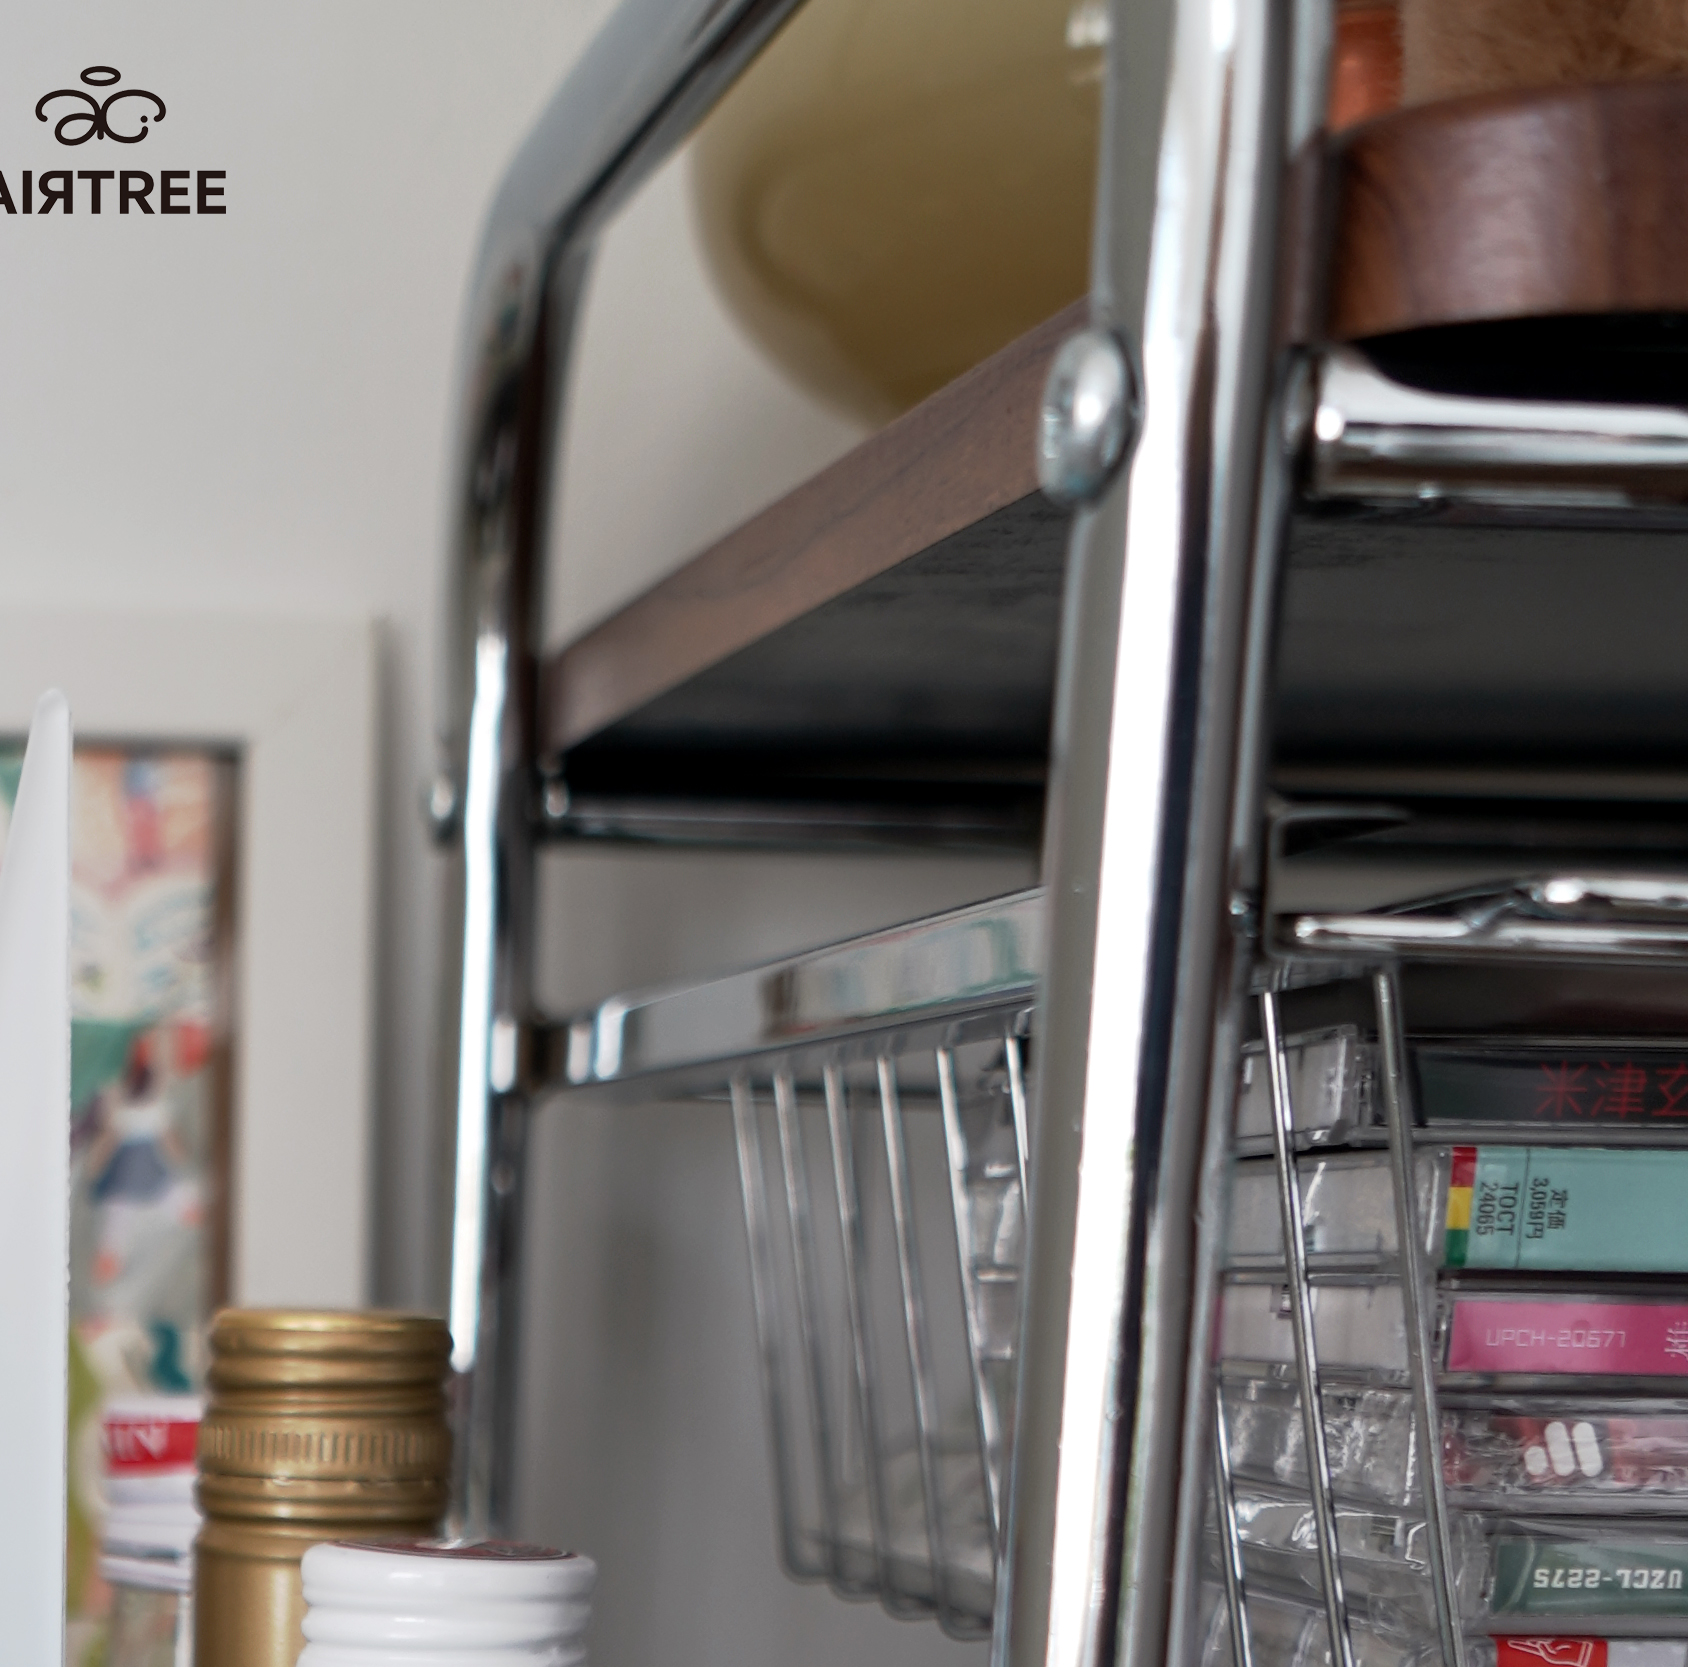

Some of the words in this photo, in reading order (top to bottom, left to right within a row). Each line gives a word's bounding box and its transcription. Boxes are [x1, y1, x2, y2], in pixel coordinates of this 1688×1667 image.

[1476, 1182, 1499, 1236] 24065
[1496, 1182, 1520, 1236] TOCT
[1533, 1568, 1683, 1590] UZCL-2275
